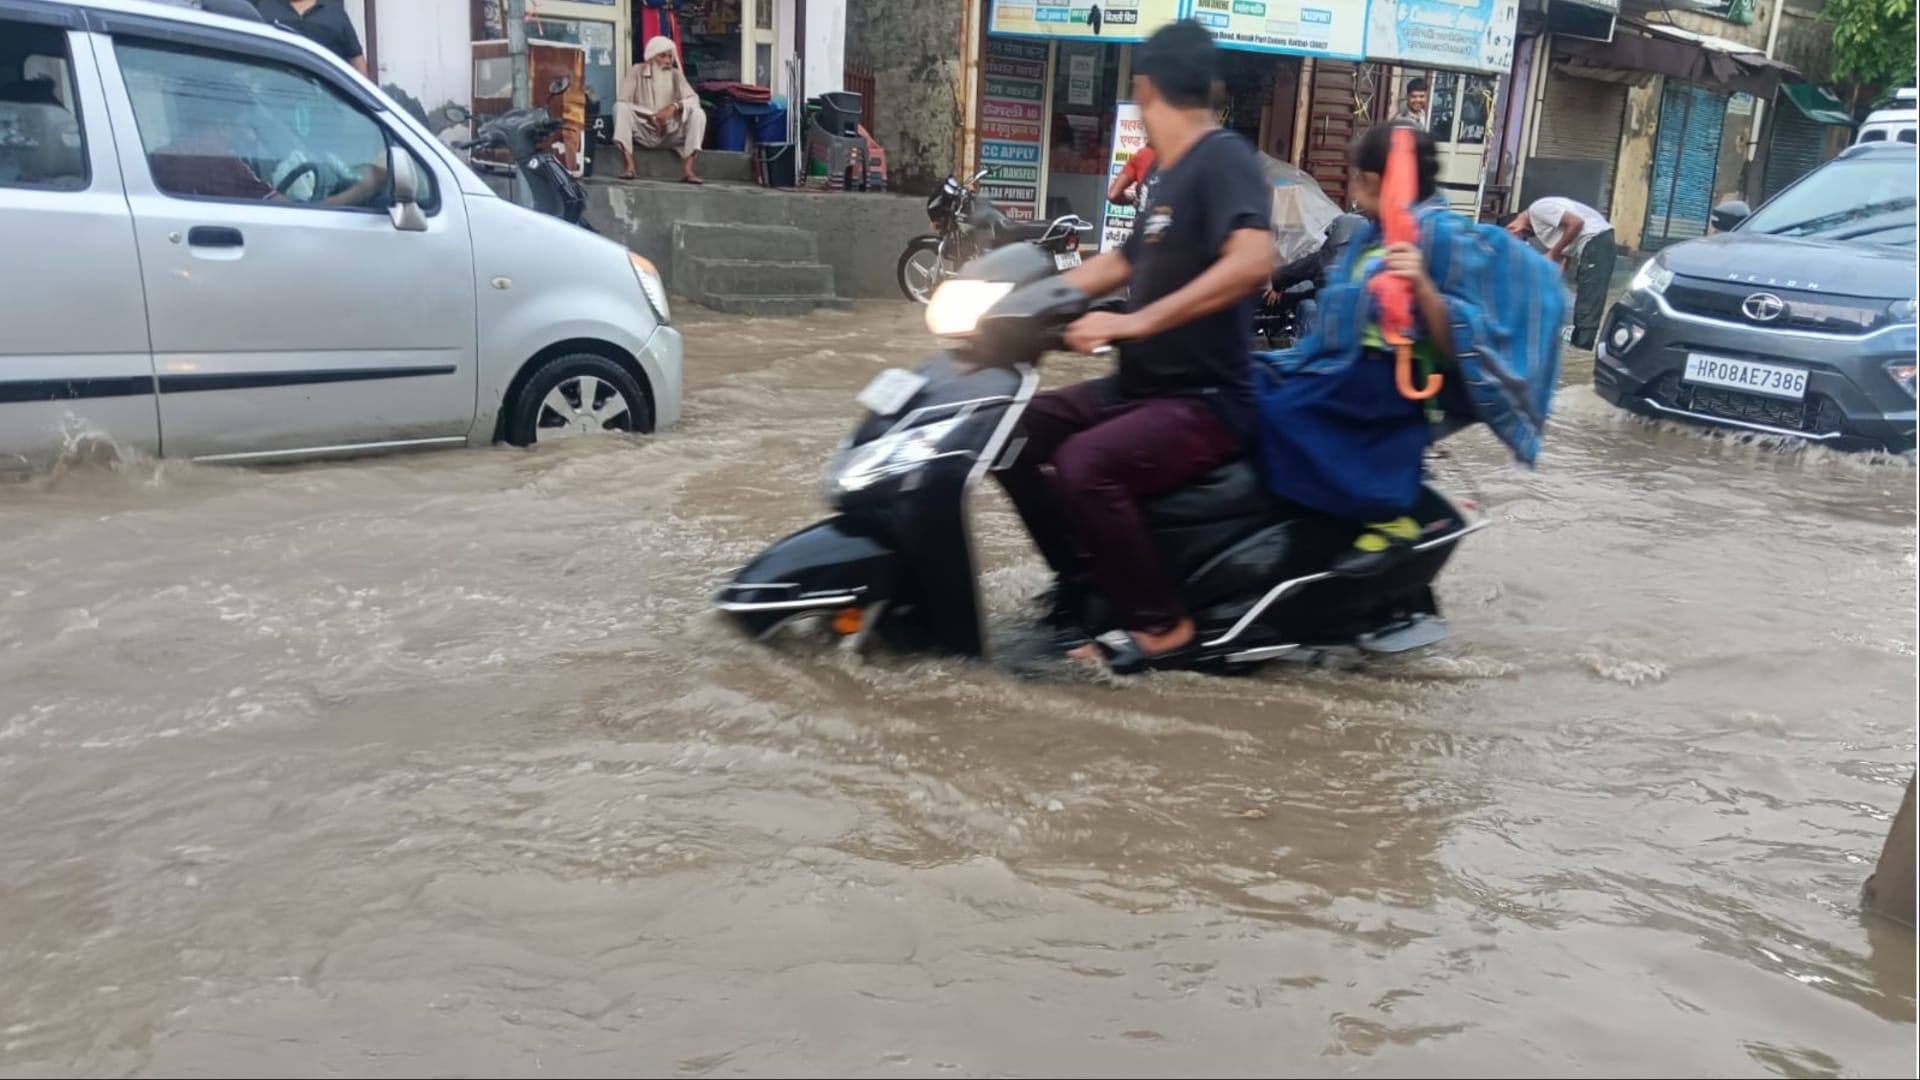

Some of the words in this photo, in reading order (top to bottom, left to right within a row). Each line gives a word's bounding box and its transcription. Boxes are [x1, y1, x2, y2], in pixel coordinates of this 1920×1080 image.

[1000, 147, 1035, 159] APPLY
[990, 187, 1003, 198] TAX
[1003, 188, 1035, 200] PAYMENT
[1728, 273, 1819, 288] NEXON
[1697, 359, 1804, 393] HR08AE7386
